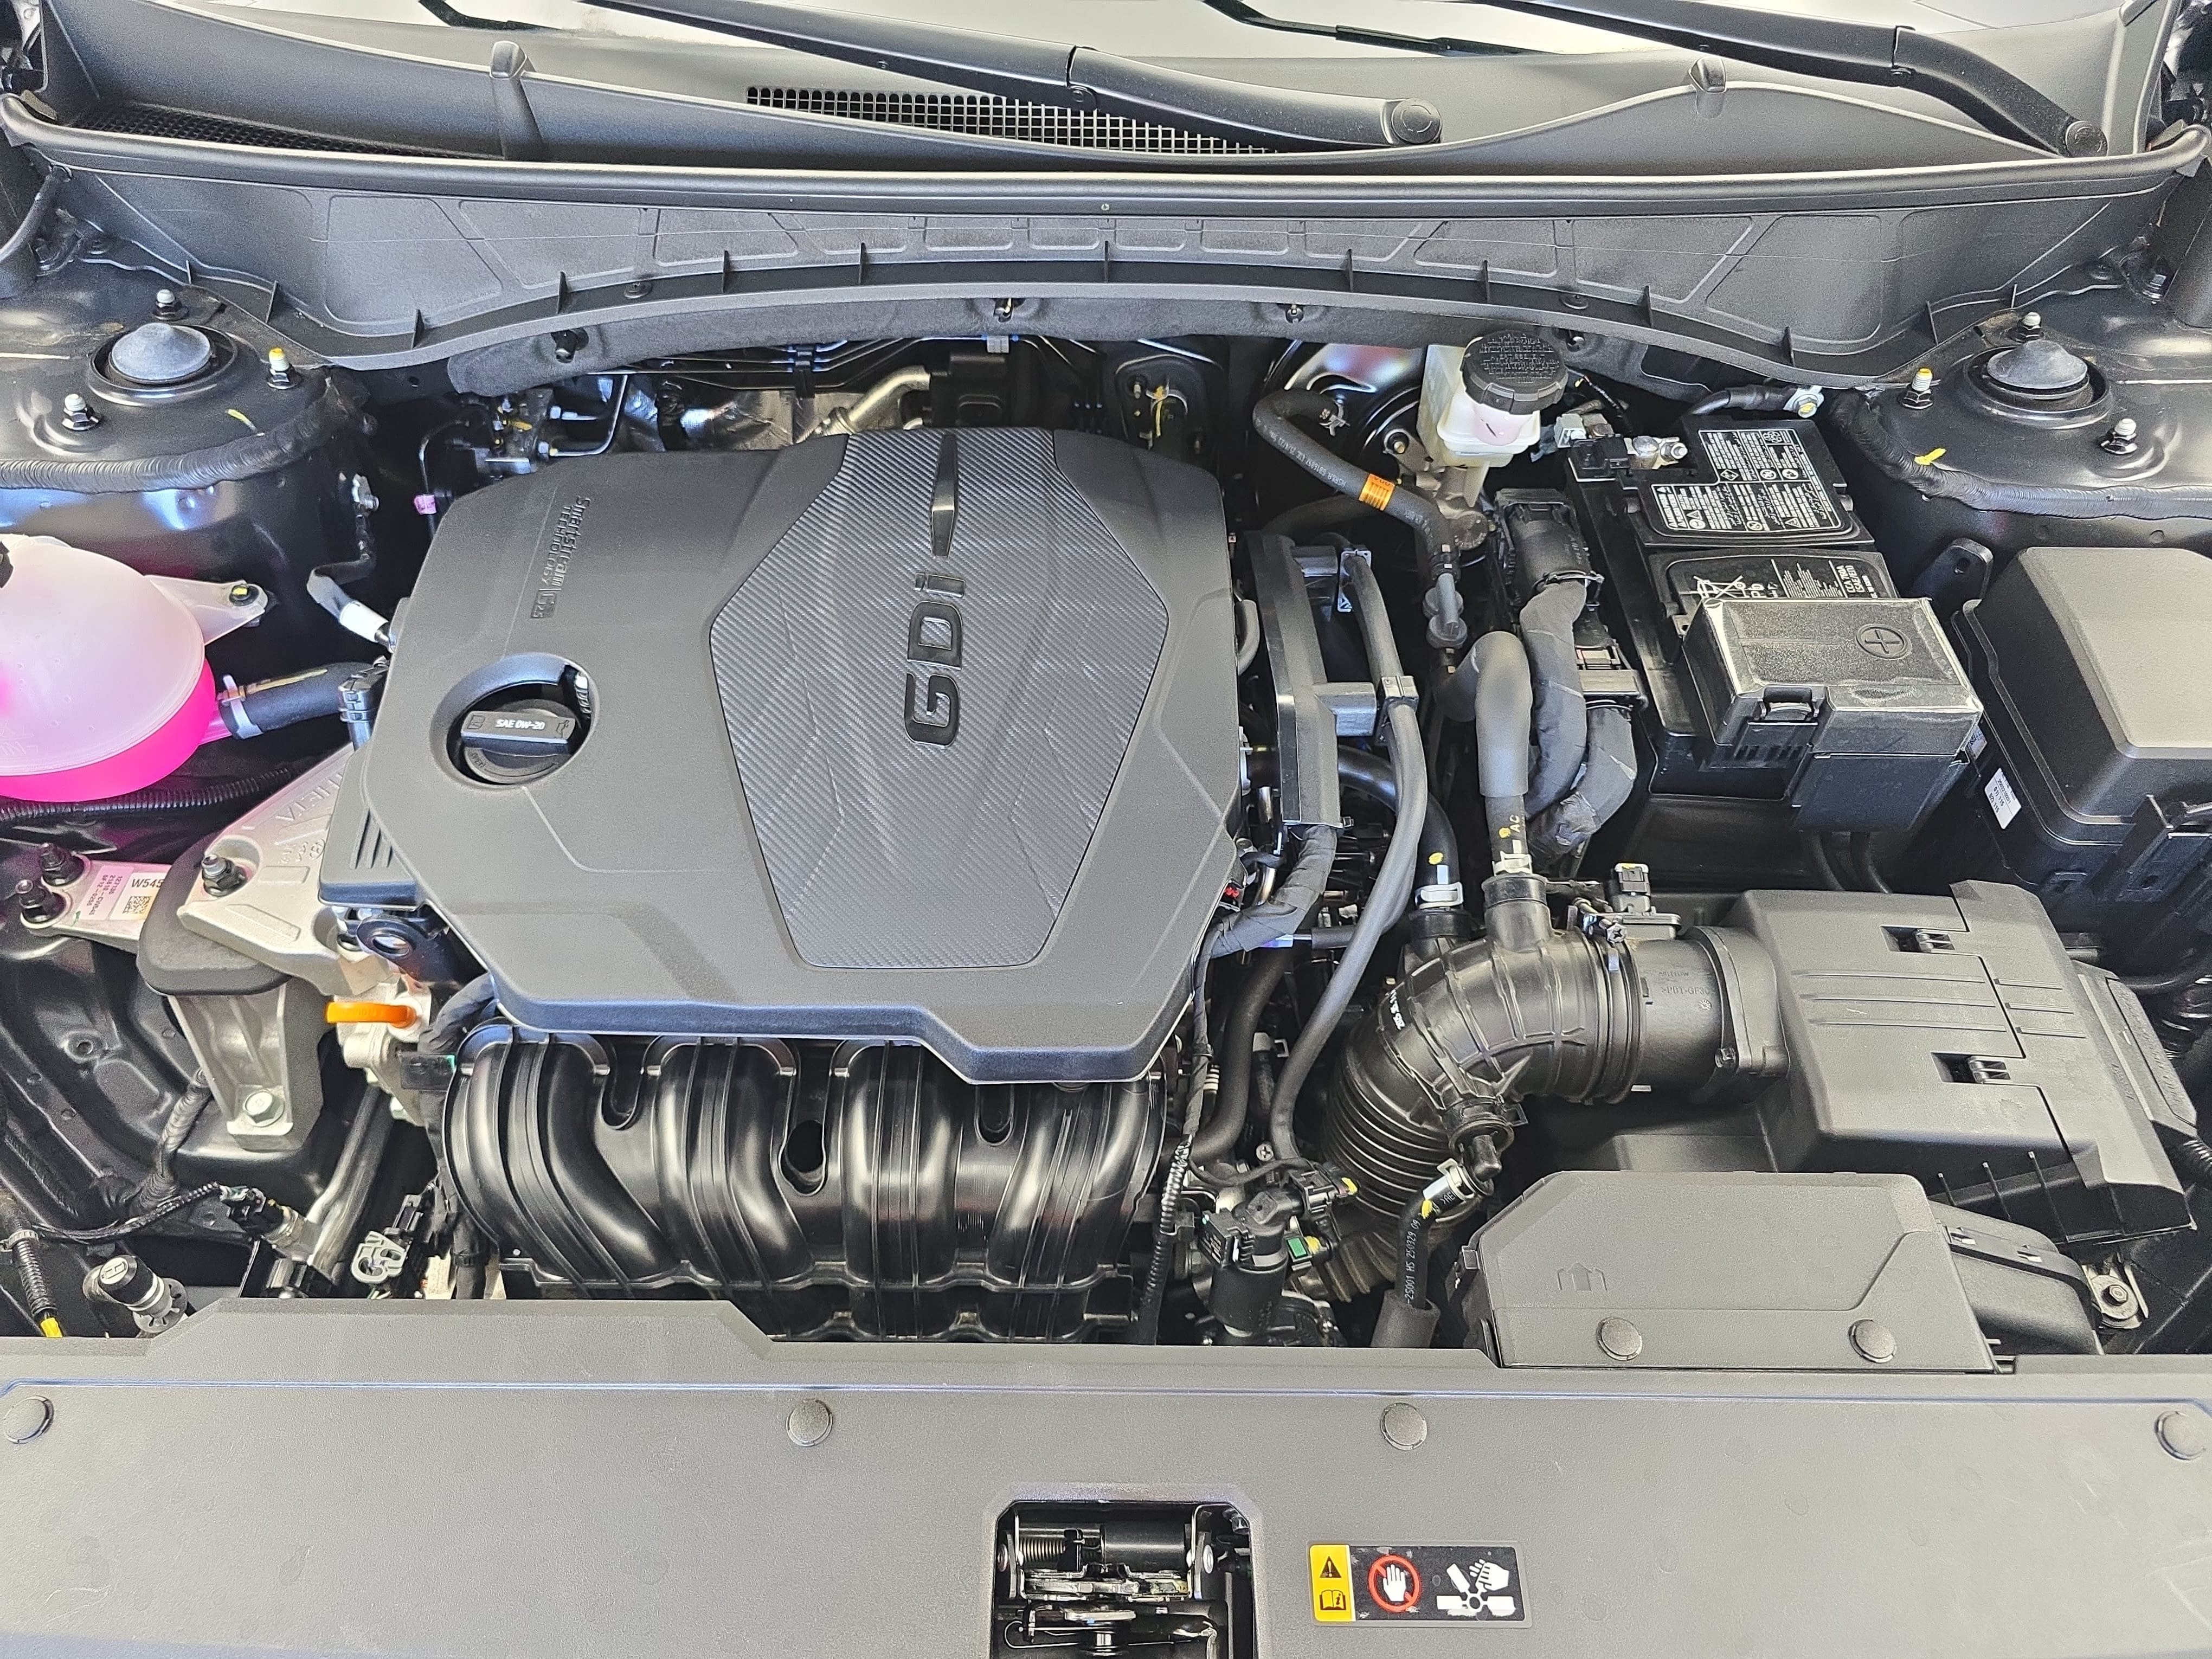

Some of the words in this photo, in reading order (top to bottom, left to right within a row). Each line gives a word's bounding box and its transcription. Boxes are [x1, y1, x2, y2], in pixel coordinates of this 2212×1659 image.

[542, 506, 572, 586] TECHNOLOGY
[551, 495, 591, 587] Smartstream
[1843, 581, 1856, 593] CCA
[904, 573, 966, 749] GDi
[495, 719, 516, 728] SAE
[516, 720, 546, 730] 0W-20
[1509, 814, 1520, 833] AC
[1411, 1219, 1420, 1230] 09
[1406, 1231, 1417, 1259] 250329
[1405, 1261, 1415, 1272] HS
[1404, 1275, 1416, 1304] -25001
